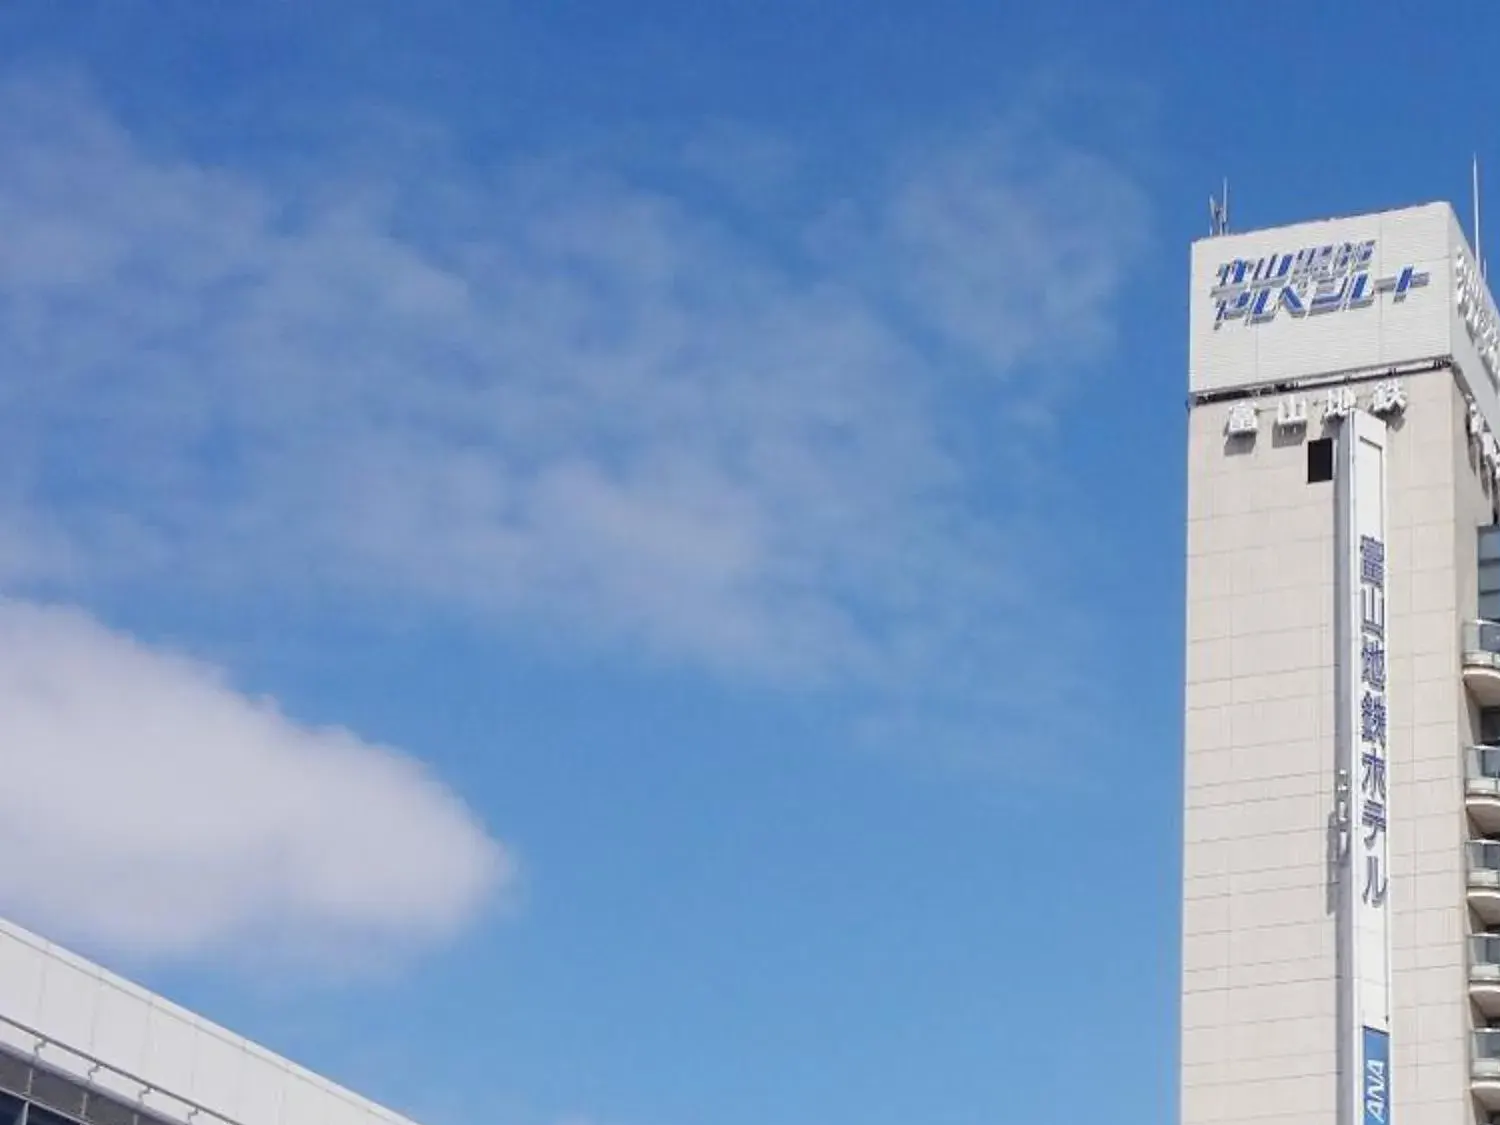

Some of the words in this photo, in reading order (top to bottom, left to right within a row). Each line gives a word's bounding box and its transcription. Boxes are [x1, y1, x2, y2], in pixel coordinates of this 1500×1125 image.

[1360, 534, 1388, 908] 富山地鉄ホテル
[1366, 1058, 1387, 1124] ANA
